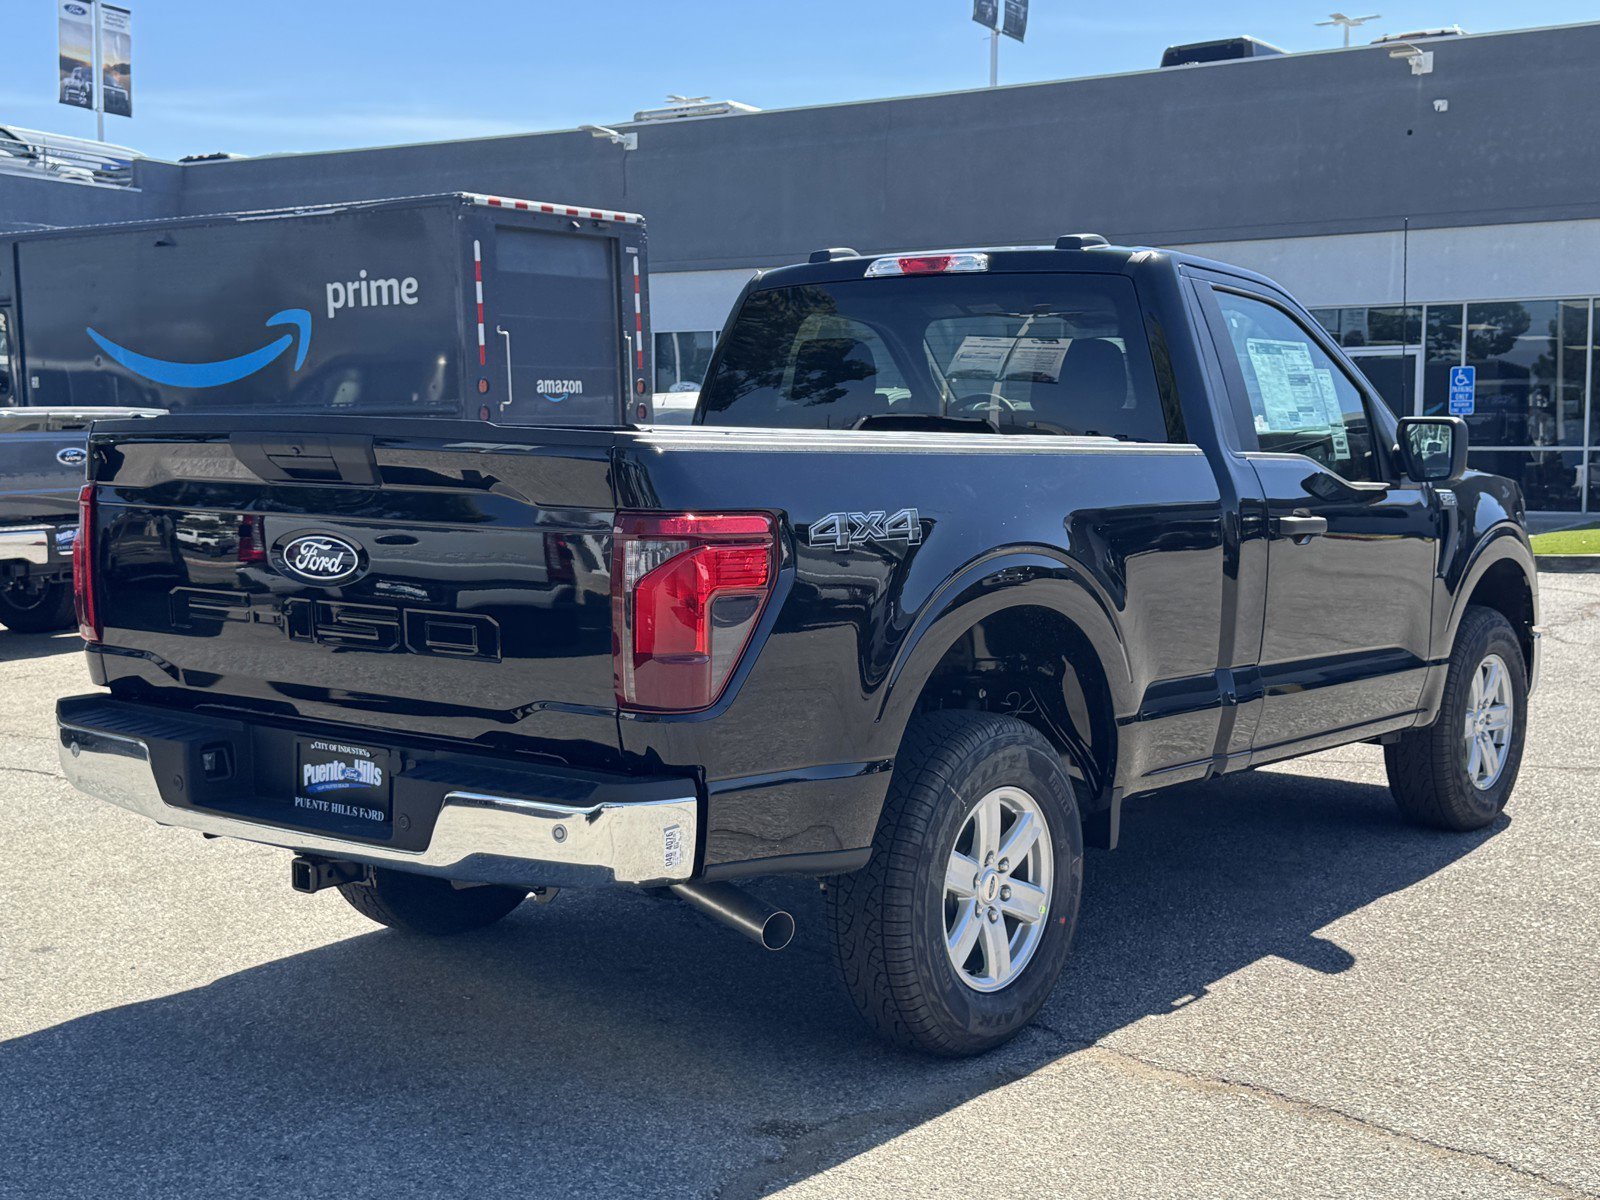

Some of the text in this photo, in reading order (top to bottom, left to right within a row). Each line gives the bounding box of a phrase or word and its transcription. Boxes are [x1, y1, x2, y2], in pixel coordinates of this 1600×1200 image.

[326, 269, 419, 319] prime
[536, 379, 583, 394] amazon
[295, 541, 345, 573] Ford
[169, 586, 502, 663] F-150
[314, 741, 367, 757] CITY OF INDUSTRY
[303, 759, 382, 787] Puente Hills
[294, 797, 330, 812] PUENTE
[331, 803, 358, 817] HILLS
